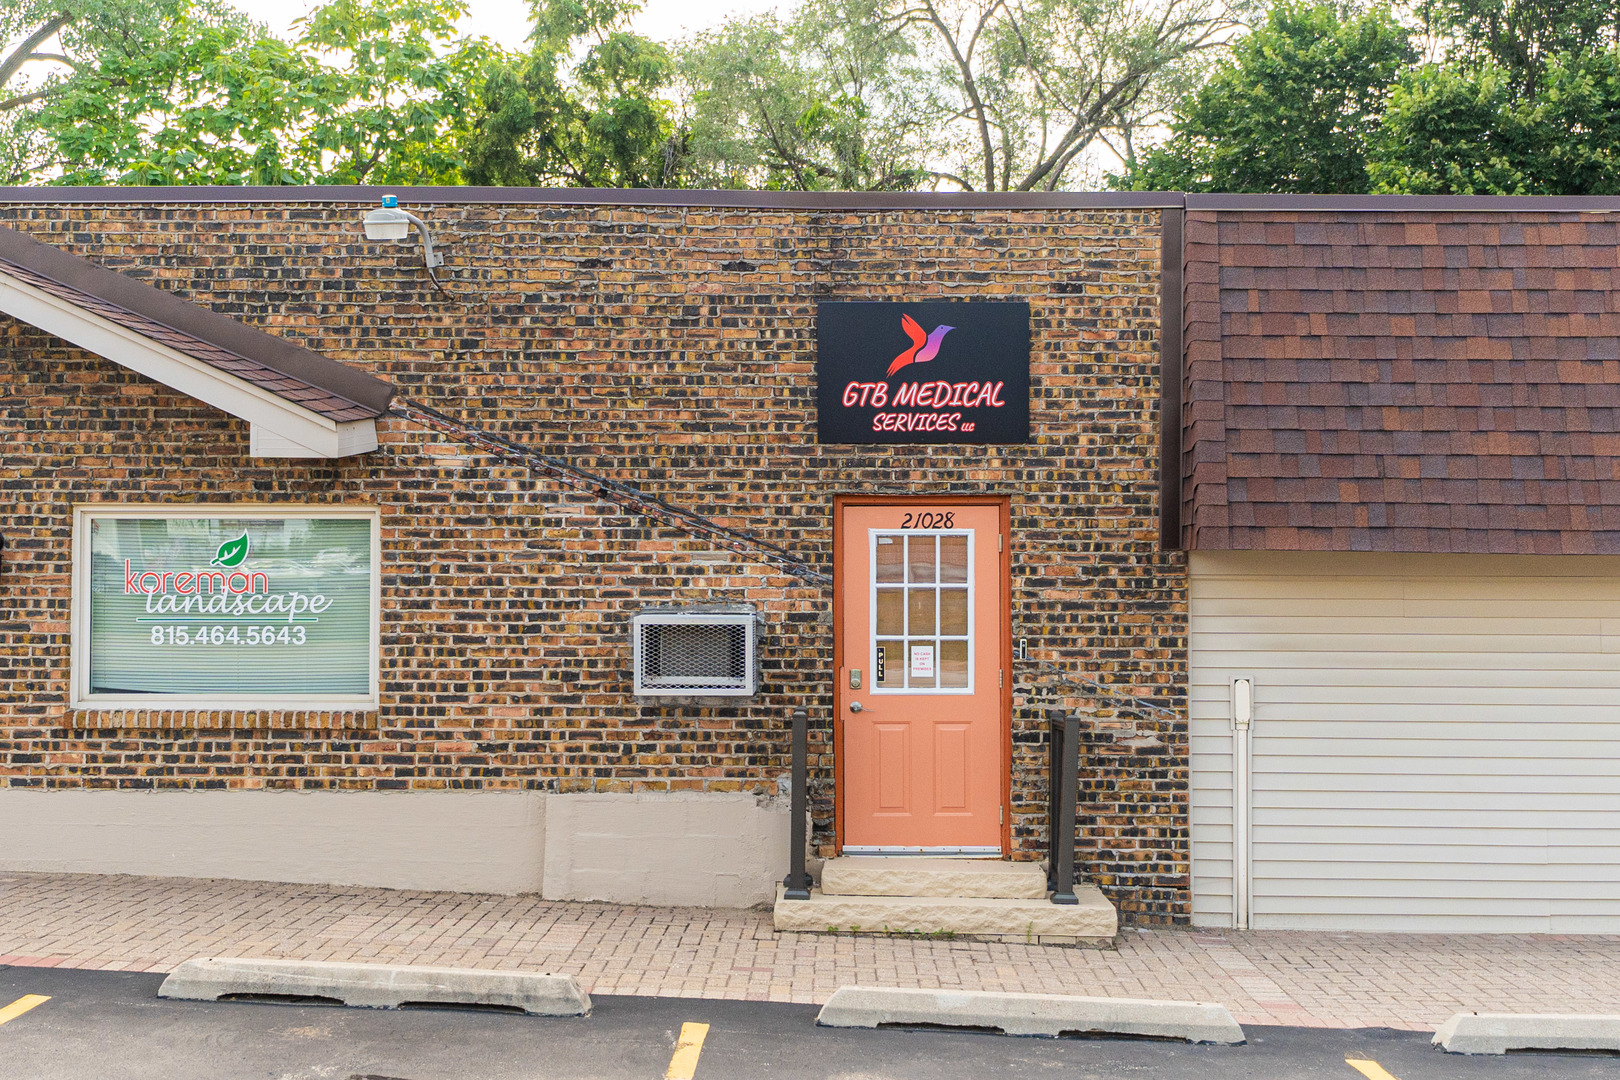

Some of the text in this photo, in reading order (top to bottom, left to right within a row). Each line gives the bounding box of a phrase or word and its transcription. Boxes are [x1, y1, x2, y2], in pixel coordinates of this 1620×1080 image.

[842, 380, 1005, 408] GTB MEDICAL
[872, 412, 962, 432] SERVICES
[901, 511, 955, 529] 21028
[124, 558, 269, 594] koreman
[145, 585, 333, 623] landscape
[150, 625, 307, 646] 815.464.5643
